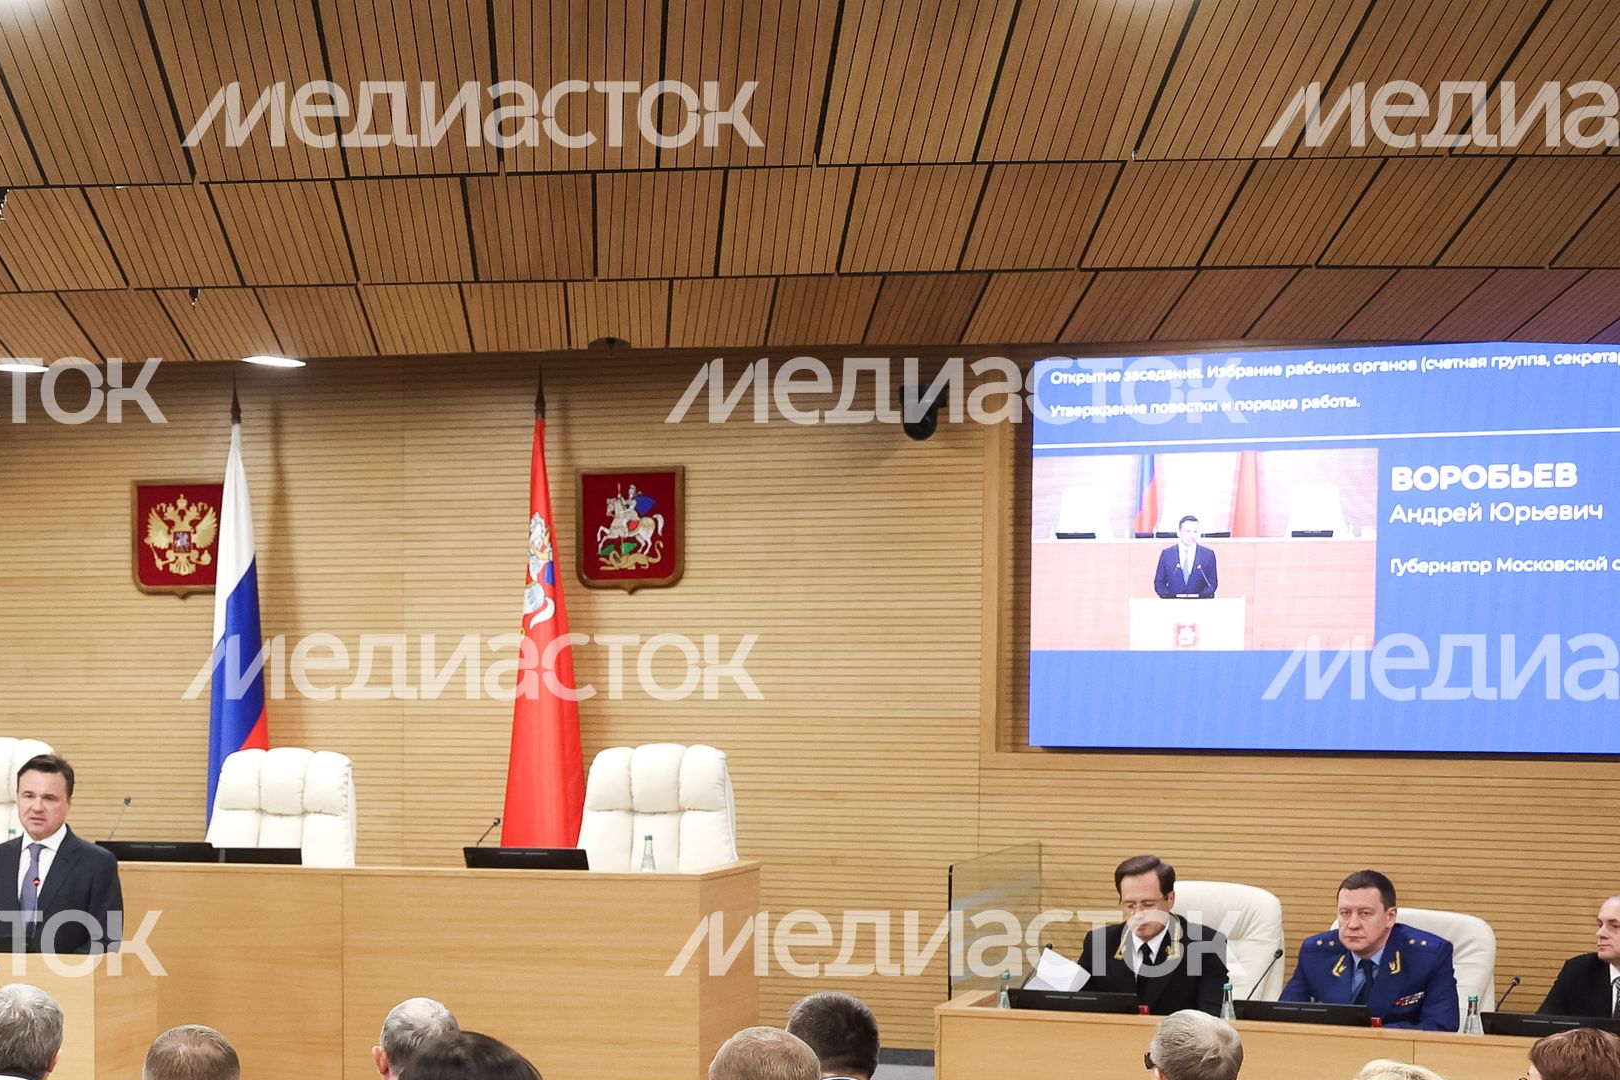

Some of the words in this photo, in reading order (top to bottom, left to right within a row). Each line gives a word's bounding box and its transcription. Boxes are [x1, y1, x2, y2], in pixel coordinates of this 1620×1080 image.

[1050, 370, 1121, 386] Открытие
[1124, 368, 1204, 382] заседания.
[1207, 364, 1283, 379] Избрание
[1285, 361, 1350, 378] рабочих
[1352, 359, 1417, 375] органов
[1421, 355, 1487, 373] (счетная
[1491, 353, 1551, 370] группа,
[1553, 351, 1620, 367] секрета
[1049, 403, 1147, 419] Утверждение
[1150, 400, 1218, 414] повестки
[1221, 399, 1231, 412] и
[1235, 398, 1298, 414] порядка
[1301, 394, 1360, 412] работы.
[1391, 462, 1578, 492] ВОРОБЬЕВ
[1388, 502, 1483, 527] Андрей
[1489, 502, 1603, 526] Юрьевич
[1390, 557, 1492, 577] Губернатор
[1496, 556, 1608, 573] Московской
